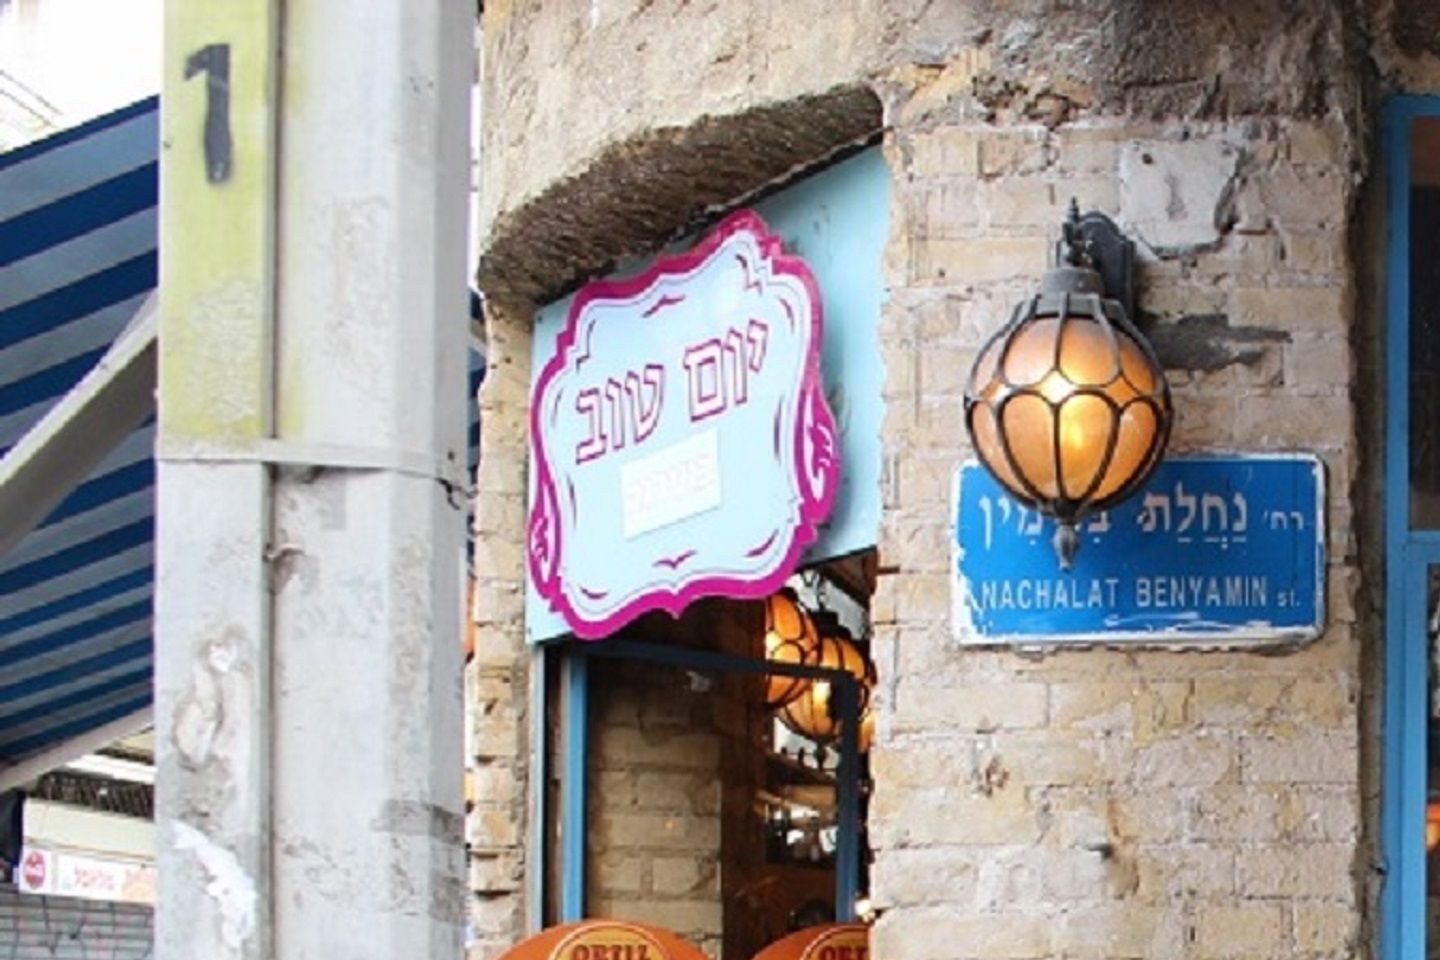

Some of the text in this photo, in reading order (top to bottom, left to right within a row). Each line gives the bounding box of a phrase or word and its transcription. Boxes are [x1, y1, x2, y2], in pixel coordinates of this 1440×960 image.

[184, 43, 231, 184] 1
[575, 318, 768, 466] יום טוב
[981, 577, 1120, 610] NACHALAT
[1136, 575, 1267, 608] BENYAMIN
